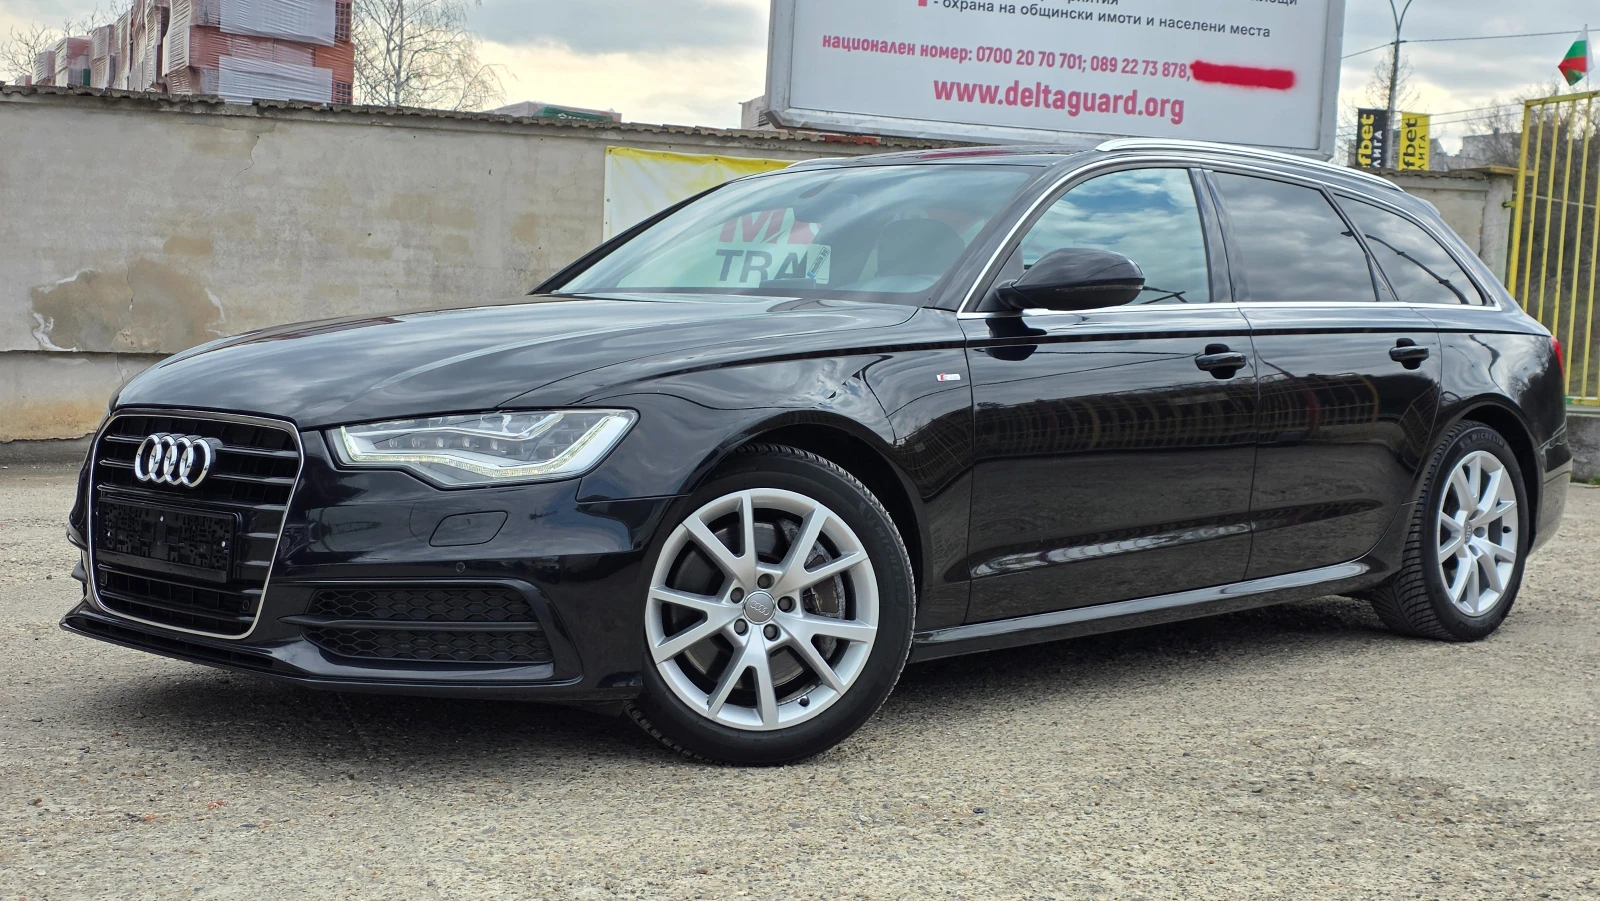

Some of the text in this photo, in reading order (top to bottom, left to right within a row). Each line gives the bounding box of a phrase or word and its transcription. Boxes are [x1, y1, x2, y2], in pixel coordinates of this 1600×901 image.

[942, 0, 994, 13] охрана
[999, 3, 1016, 14] на
[1020, 3, 1093, 21] общински
[1098, 12, 1142, 25] имоти
[1146, 16, 1155, 27] и
[1159, 17, 1226, 33] населени
[1229, 24, 1271, 37] места
[822, 34, 916, 56] национален
[920, 44, 973, 64] номер:
[976, 45, 1012, 64] 0700
[1016, 49, 1035, 66] 20
[1038, 51, 1056, 68] 70
[1059, 52, 1087, 73] 701;
[1090, 55, 1118, 73] 089
[1121, 58, 1139, 75] 22
[1142, 59, 1158, 76] 73
[933, 80, 1185, 125] www.deltaguard.org
[1357, 113, 1375, 168] fbet
